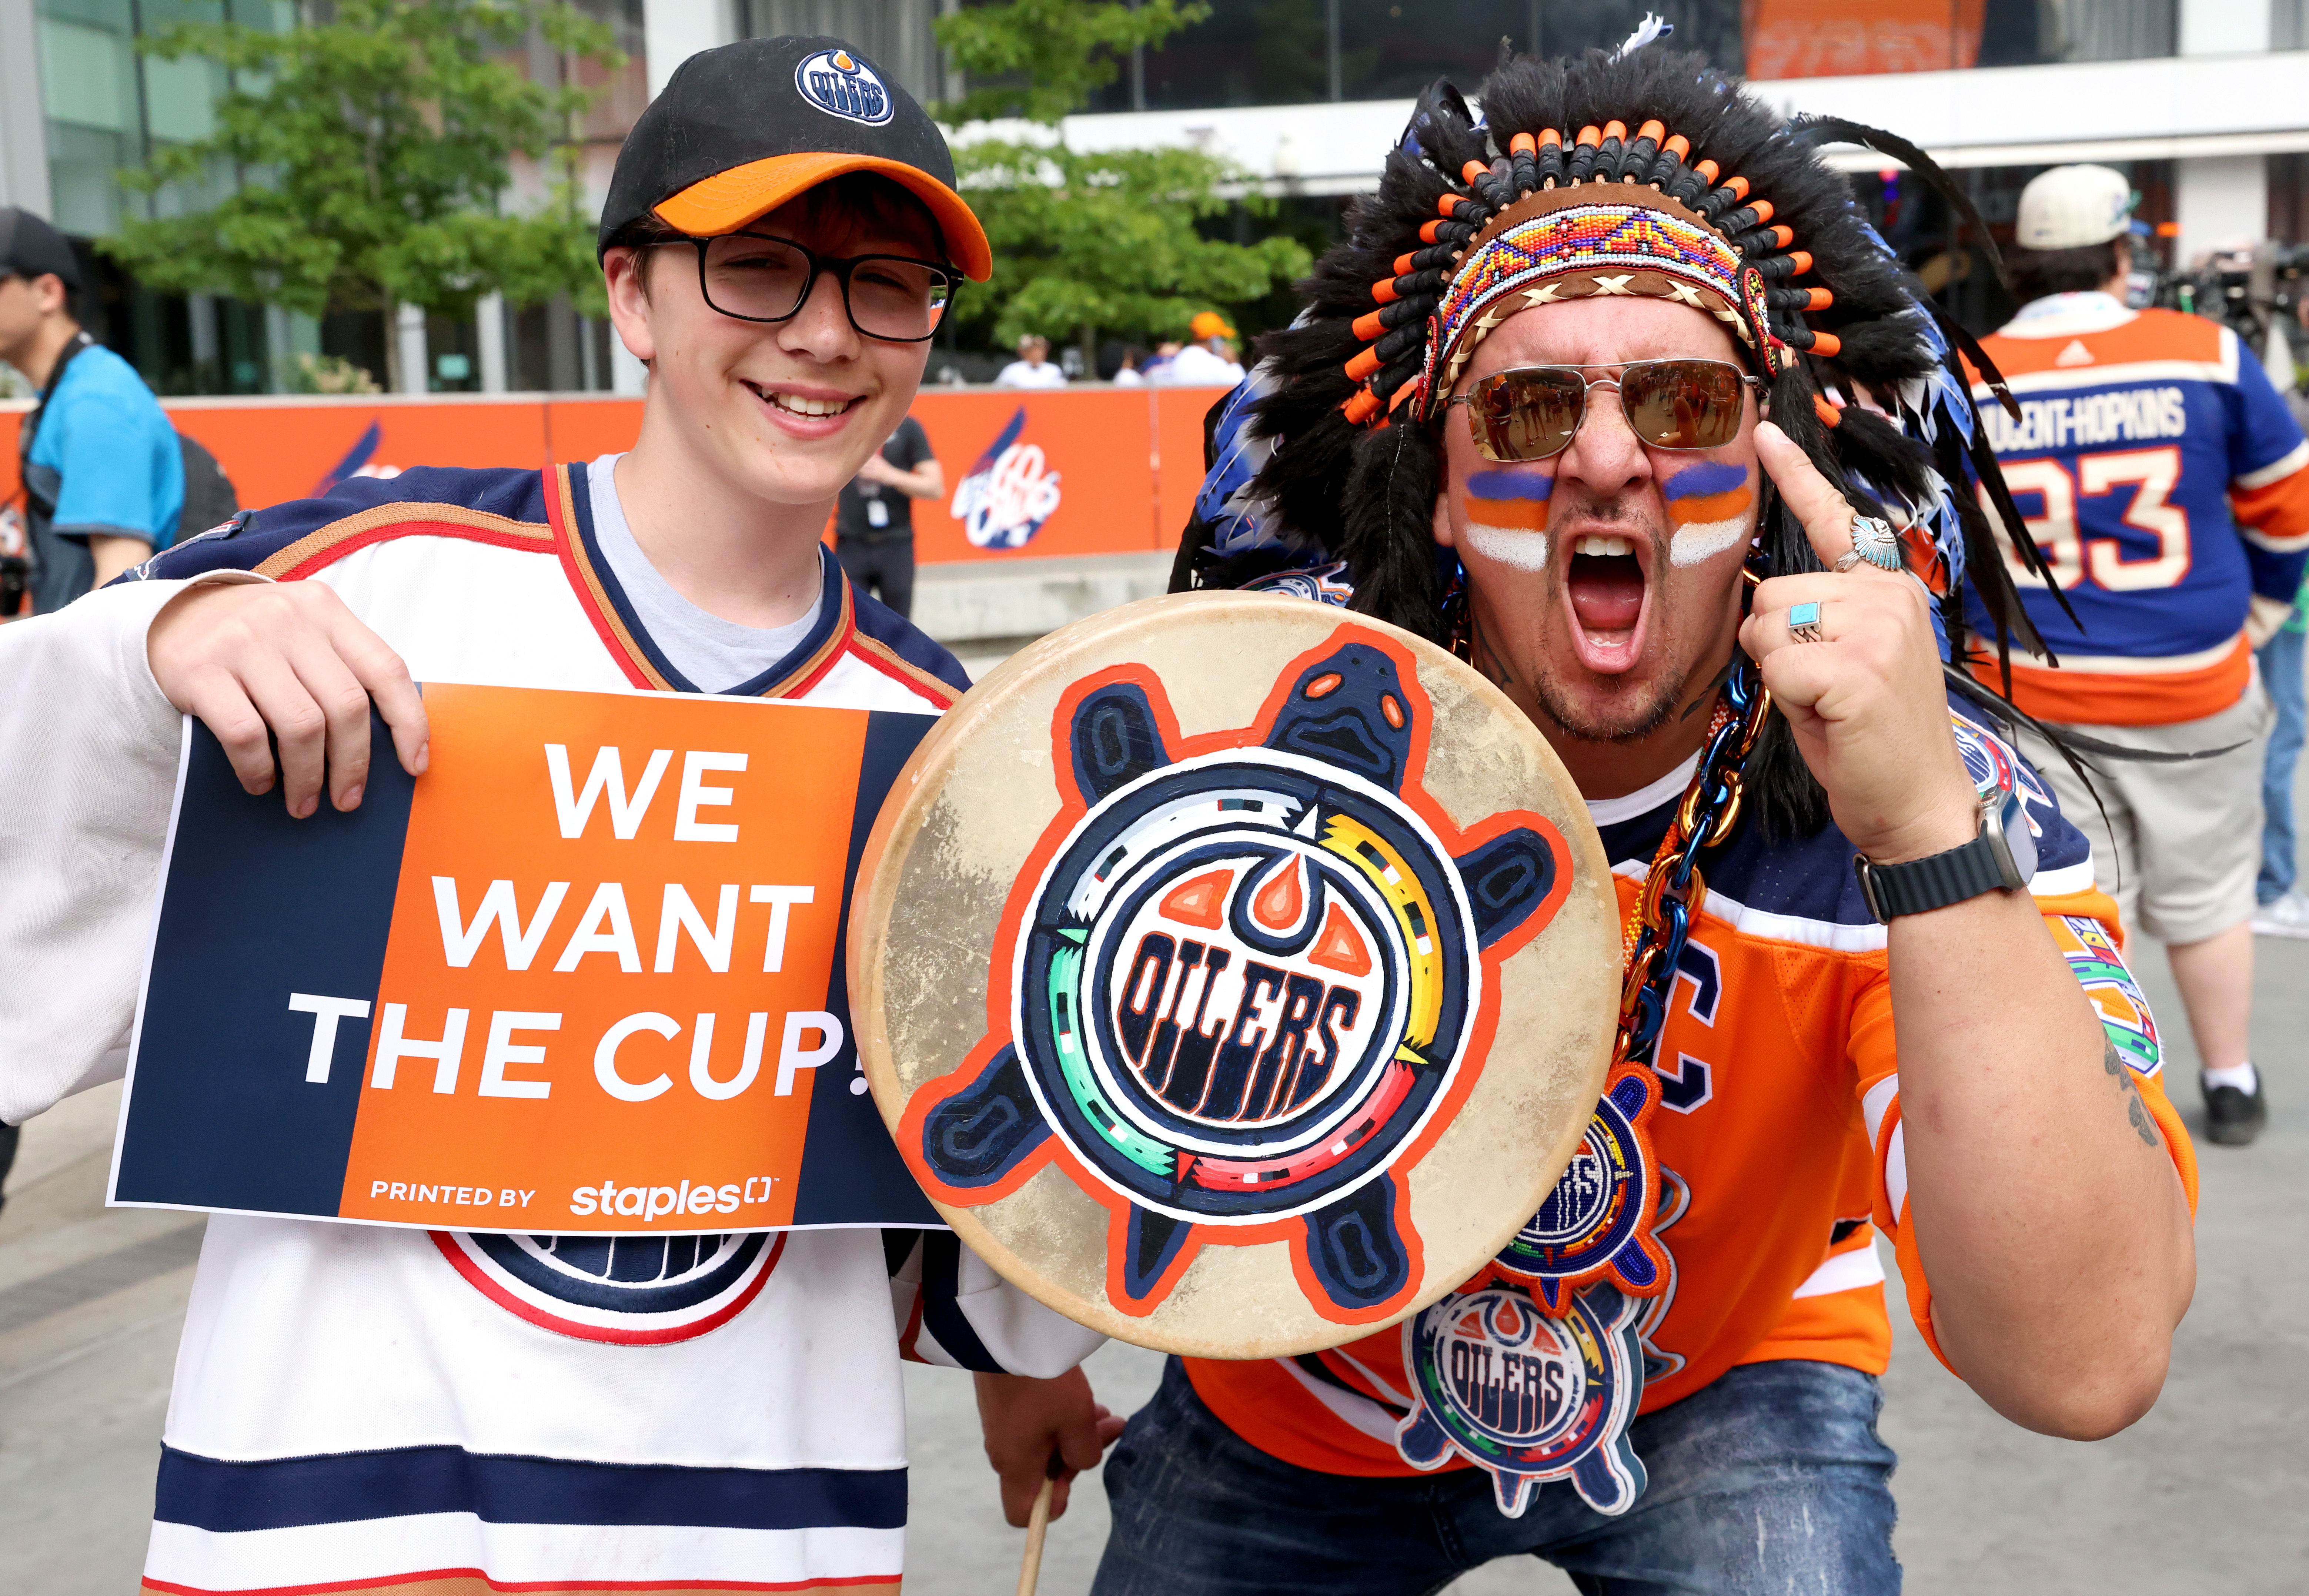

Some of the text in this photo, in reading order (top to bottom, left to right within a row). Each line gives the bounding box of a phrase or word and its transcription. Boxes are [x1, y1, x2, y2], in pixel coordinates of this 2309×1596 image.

[809, 70, 884, 117] OILERS
[1976, 386, 2186, 454] UGENT-HOPKINS
[1975, 444, 2192, 592] 93
[544, 743, 749, 843] WE
[431, 875, 815, 973] WANT
[288, 992, 563, 1099] THE
[1117, 930, 1362, 1122] OILERS
[1631, 937, 1722, 1115] C
[370, 1180, 536, 1207] PRINTED BY
[569, 1179, 741, 1222] staples
[1451, 1339, 1564, 1434] OILERS
